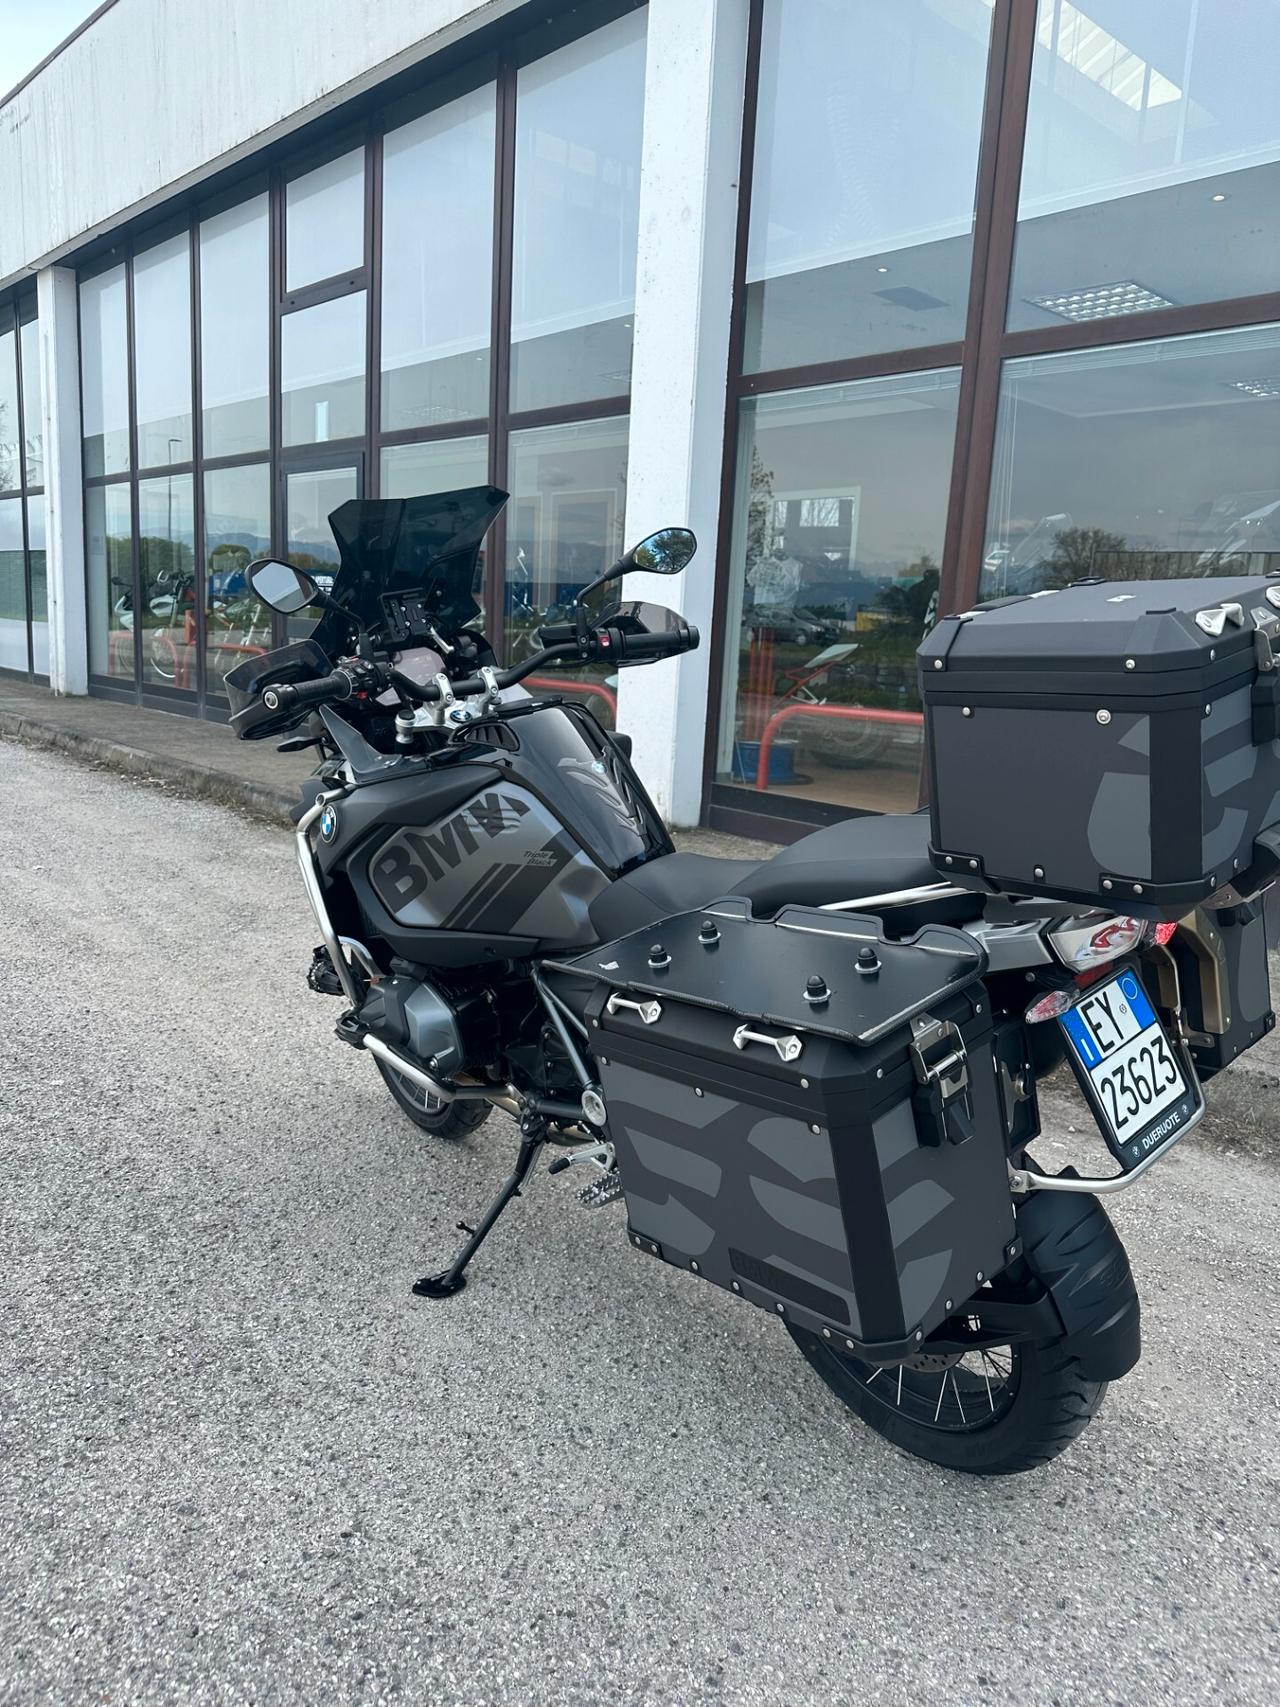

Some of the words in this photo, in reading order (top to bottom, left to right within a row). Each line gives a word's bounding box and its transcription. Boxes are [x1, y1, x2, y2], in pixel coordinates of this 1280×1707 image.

[373, 793, 530, 913] BMW
[1081, 992, 1124, 1053] EY
[1101, 1035, 1177, 1130] 23623
[1142, 1111, 1181, 1149] DUERUOTE
